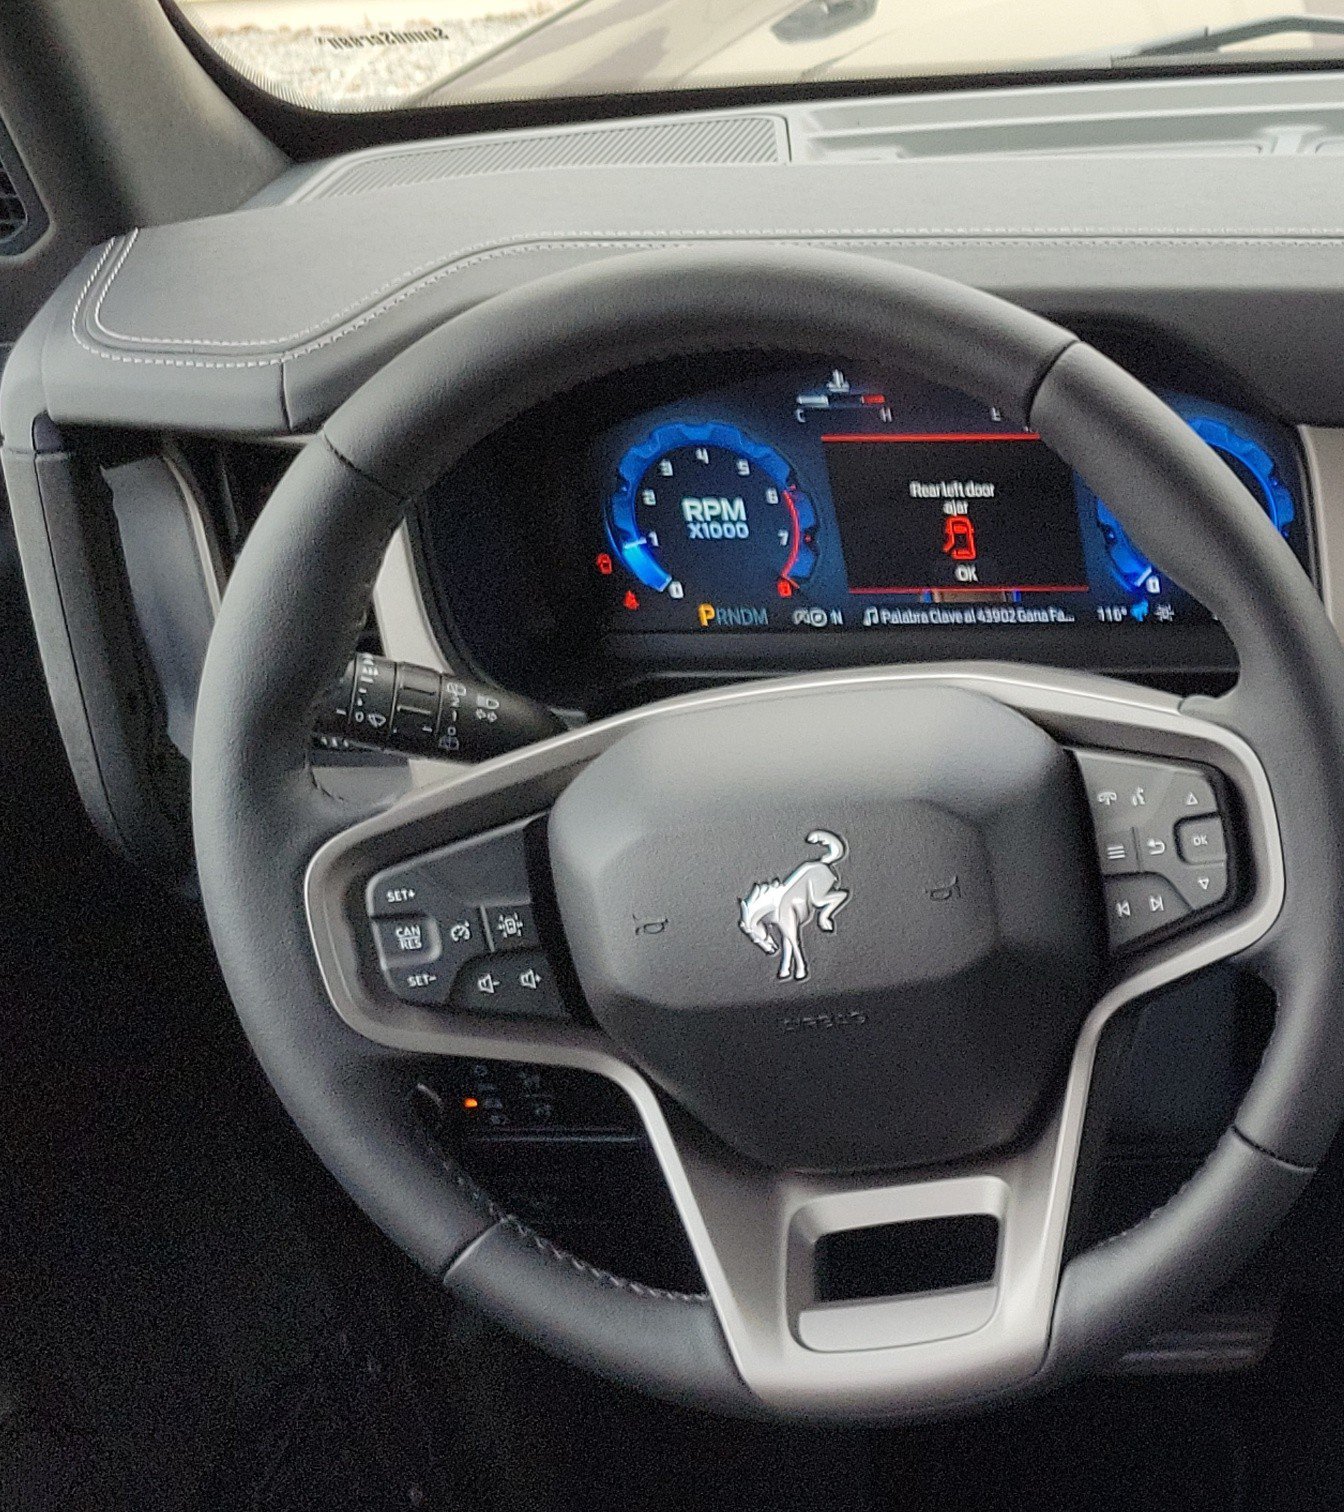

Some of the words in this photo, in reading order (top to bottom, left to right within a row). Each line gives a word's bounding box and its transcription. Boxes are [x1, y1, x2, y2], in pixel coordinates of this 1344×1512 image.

[696, 448, 709, 464] 4
[660, 460, 673, 476] 3
[737, 459, 750, 476] 5
[642, 489, 656, 506] 2
[909, 481, 940, 498] Rear
[941, 480, 965, 498] left
[965, 480, 995, 498] door
[681, 498, 747, 522] RPM
[943, 499, 969, 516] ajar
[649, 531, 660, 547] 1
[687, 522, 750, 540] X1000
[778, 529, 789, 547] 7
[954, 564, 979, 582] OK
[669, 580, 685, 599] 0
[881, 606, 929, 625] Palabra
[929, 606, 963, 624] Clave
[964, 606, 976, 624] al
[976, 605, 1017, 623] 43902
[1017, 605, 1049, 623] Gana
[1193, 835, 1208, 847] OK
[387, 888, 415, 903] SET+
[395, 926, 421, 938] CAN
